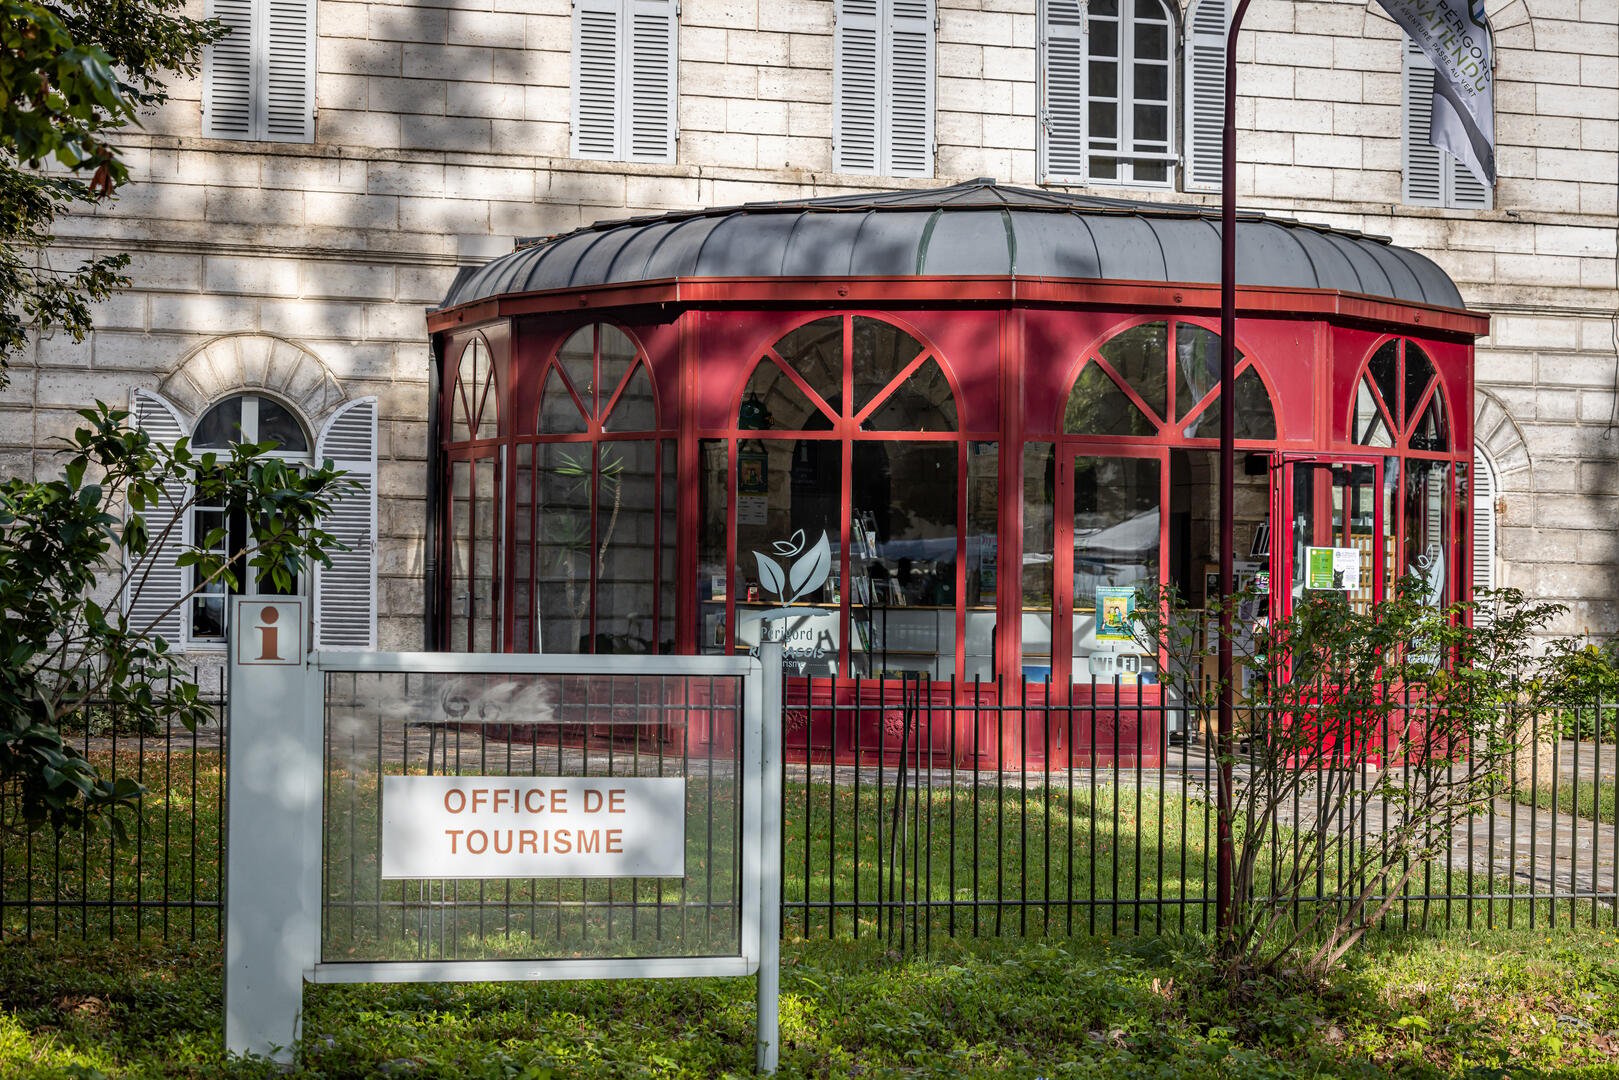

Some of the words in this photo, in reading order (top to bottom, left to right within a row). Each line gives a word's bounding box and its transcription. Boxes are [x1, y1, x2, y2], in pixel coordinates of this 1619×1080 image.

[1408, 0, 1485, 92] NATTENDU
[1436, 0, 1490, 82] PÉRIGORD
[1431, 43, 1452, 66] PASSE
[1450, 67, 1460, 79] AU
[1461, 78, 1477, 98] VERT
[444, 788, 568, 815] OFFICE
[584, 788, 626, 814] DE
[444, 828, 624, 855] TOURISME
